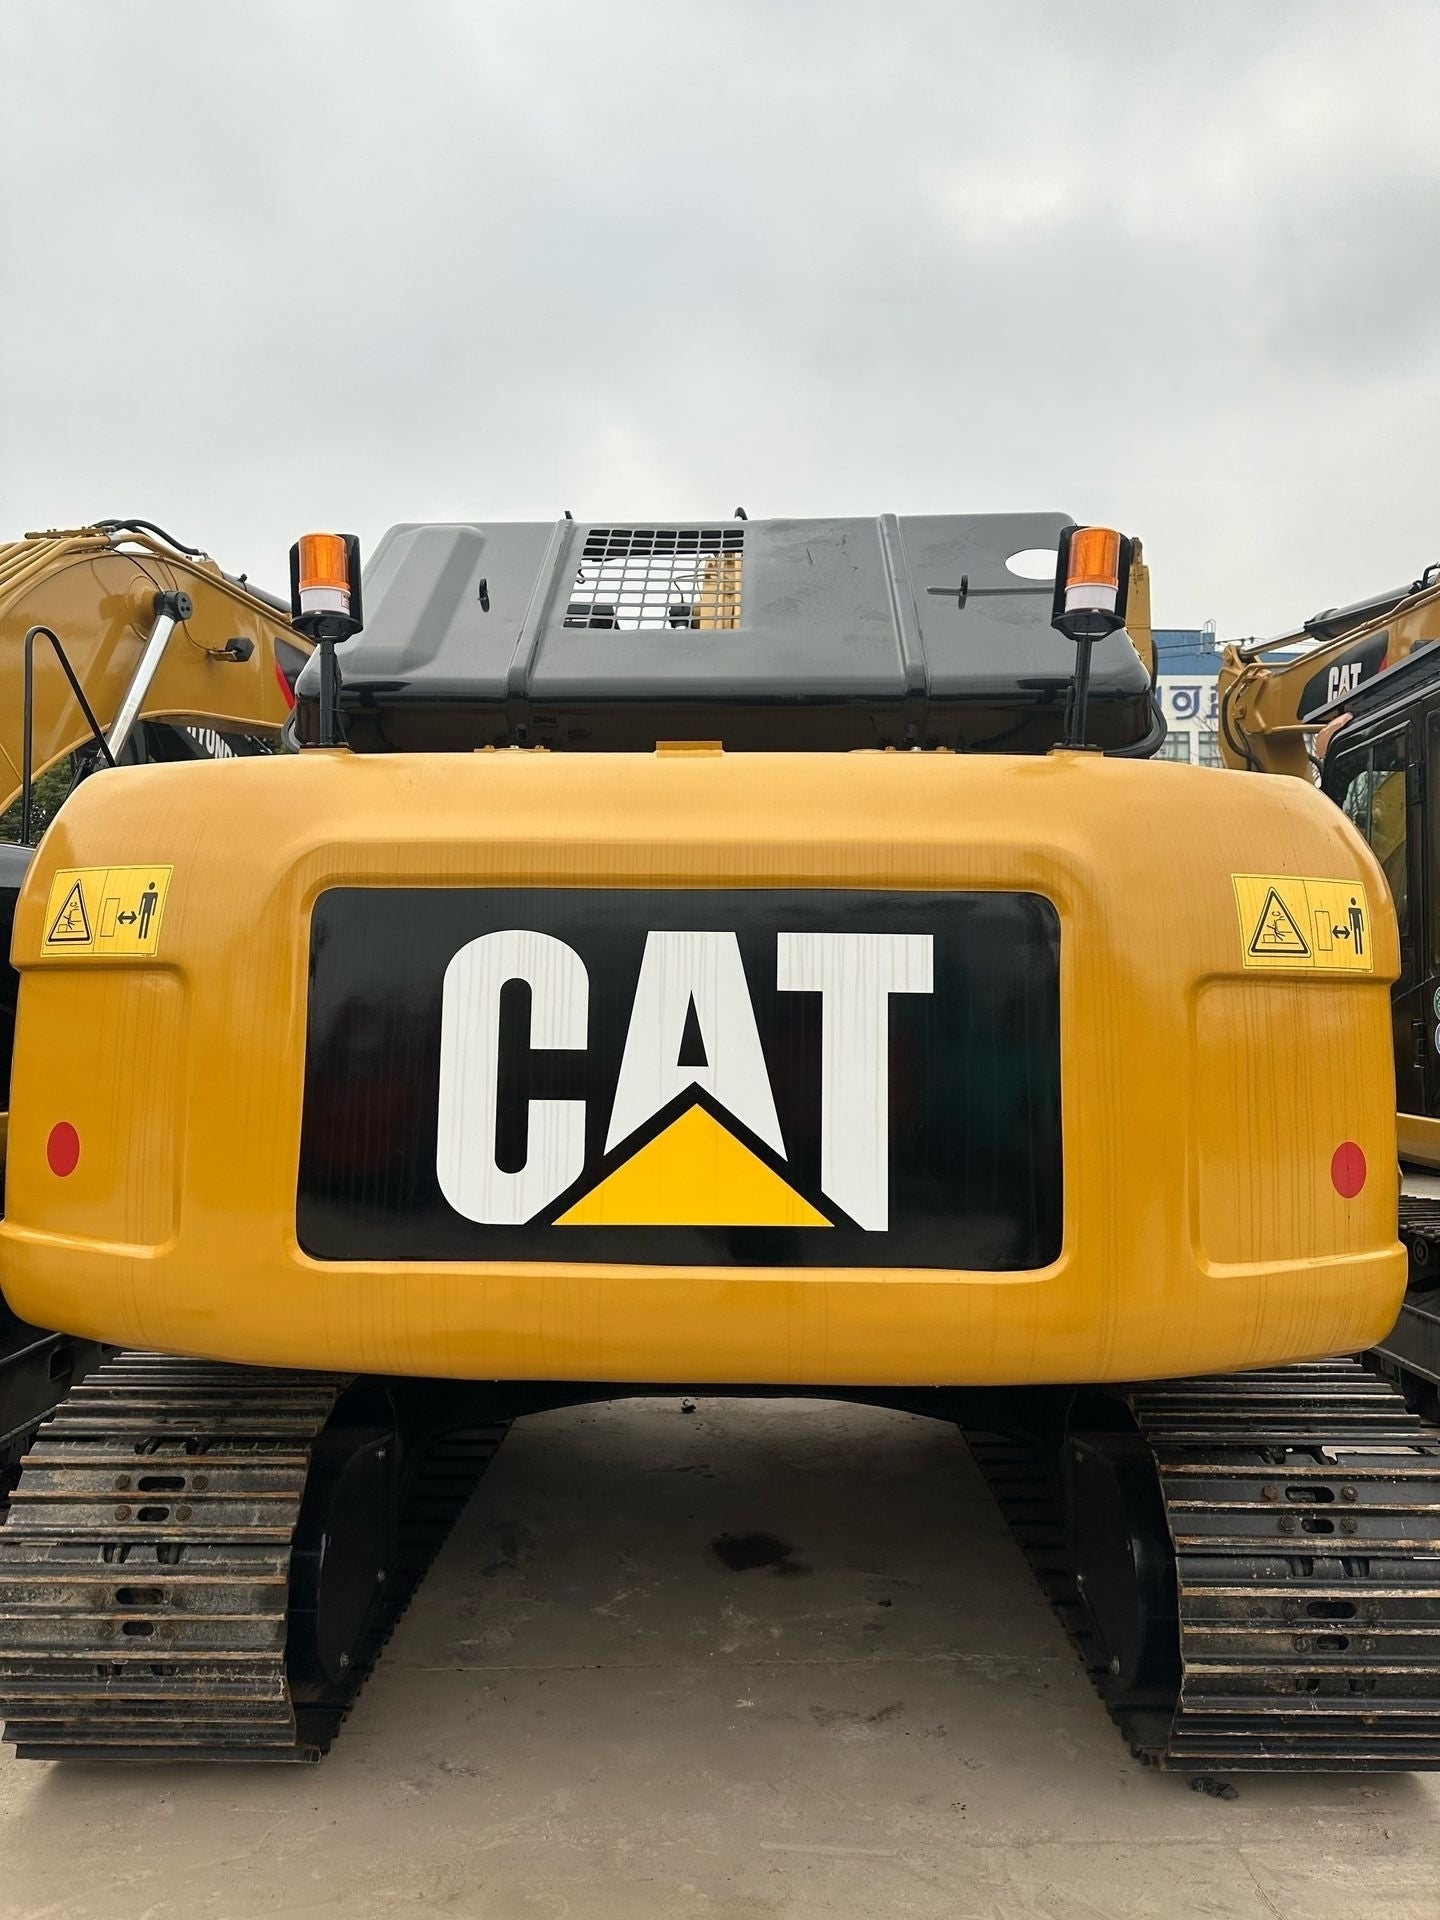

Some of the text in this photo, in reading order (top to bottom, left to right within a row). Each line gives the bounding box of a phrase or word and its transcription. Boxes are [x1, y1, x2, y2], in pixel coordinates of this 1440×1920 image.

[1327, 662, 1363, 704] CAT
[186, 726, 239, 759] YUND
[436, 929, 934, 1232] CAT
